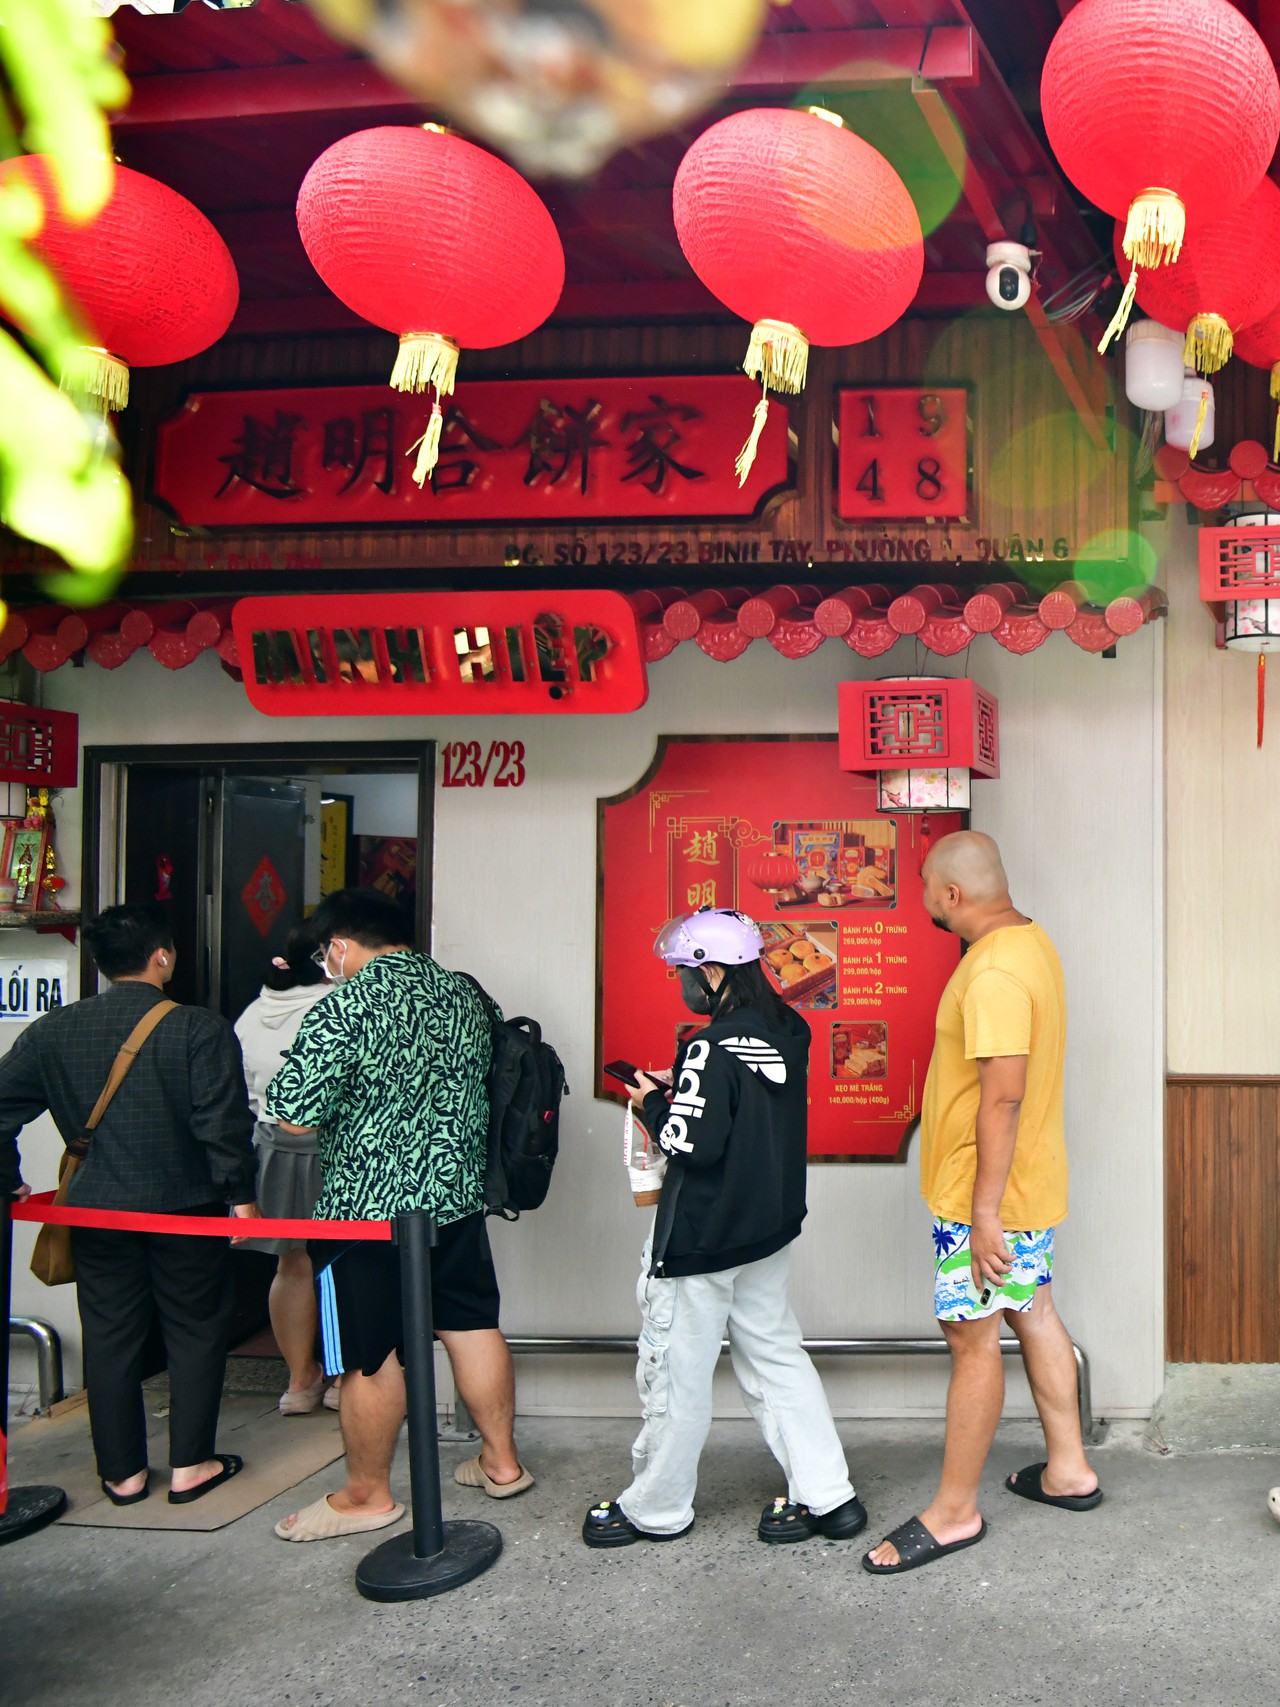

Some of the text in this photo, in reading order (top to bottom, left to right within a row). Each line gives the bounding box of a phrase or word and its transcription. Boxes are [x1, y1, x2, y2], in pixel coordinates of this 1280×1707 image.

[860, 393, 945, 437] 1 9
[856, 457, 942, 502] 4 8
[597, 540, 690, 565] 123/23
[1052, 537, 1069, 561] 6
[252, 612, 615, 701] MINH HIỆP
[441, 740, 526, 788] 123/23
[843, 925, 861, 934] BÁNH
[875, 922, 883, 934] 0
[843, 956, 861, 964] BÁNH
[875, 952, 882, 964] 1
[37, 977, 63, 1012] RA
[843, 986, 861, 994] BÁNH
[875, 982, 883, 994] 2
[869, 1096, 890, 1105] (400g)
